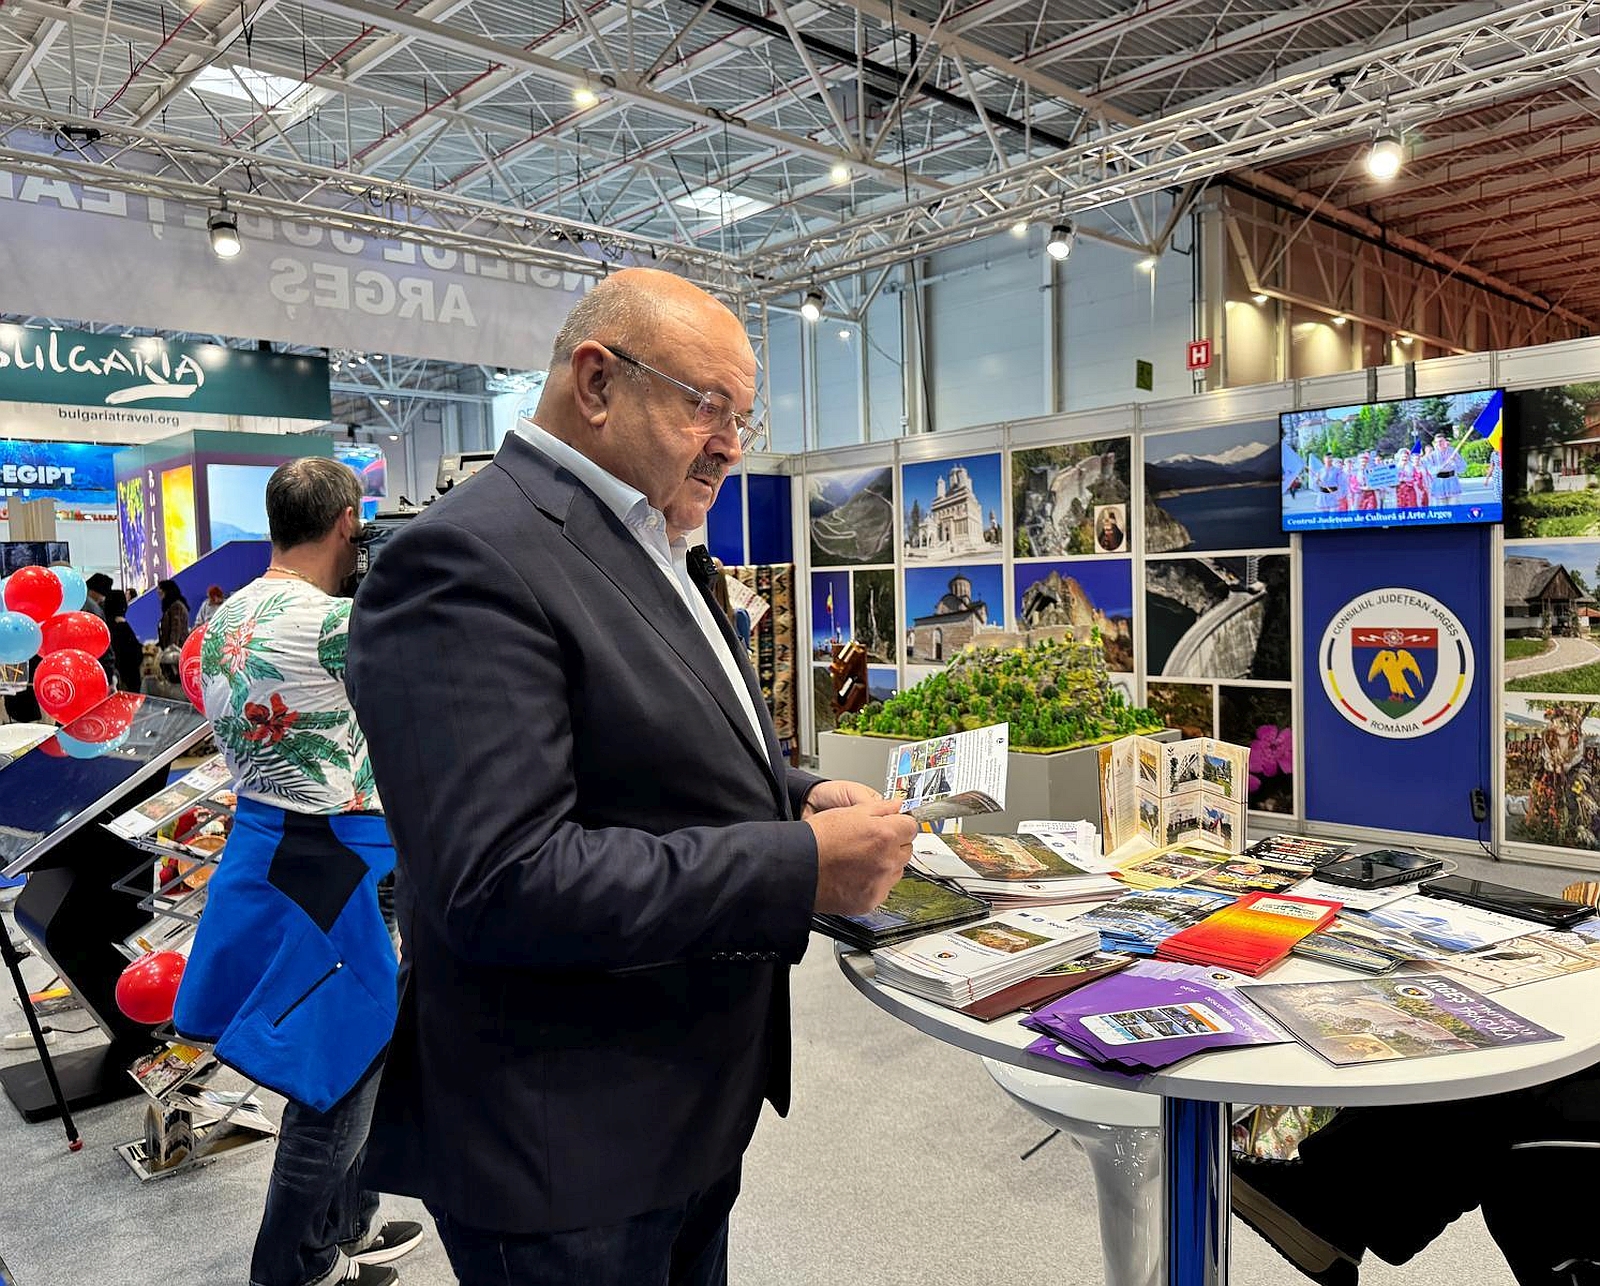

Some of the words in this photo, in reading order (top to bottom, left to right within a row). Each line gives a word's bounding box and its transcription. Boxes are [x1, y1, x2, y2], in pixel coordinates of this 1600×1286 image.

[1192, 345, 1206, 365] H
[58, 407, 180, 427] bulgariatravel.org
[3, 464, 76, 485] EGIPT
[1287, 516, 1316, 526] Centrul
[1354, 512, 1364, 522] de
[1407, 510, 1426, 520] Arte
[1333, 599, 1375, 635] CONSILIUL
